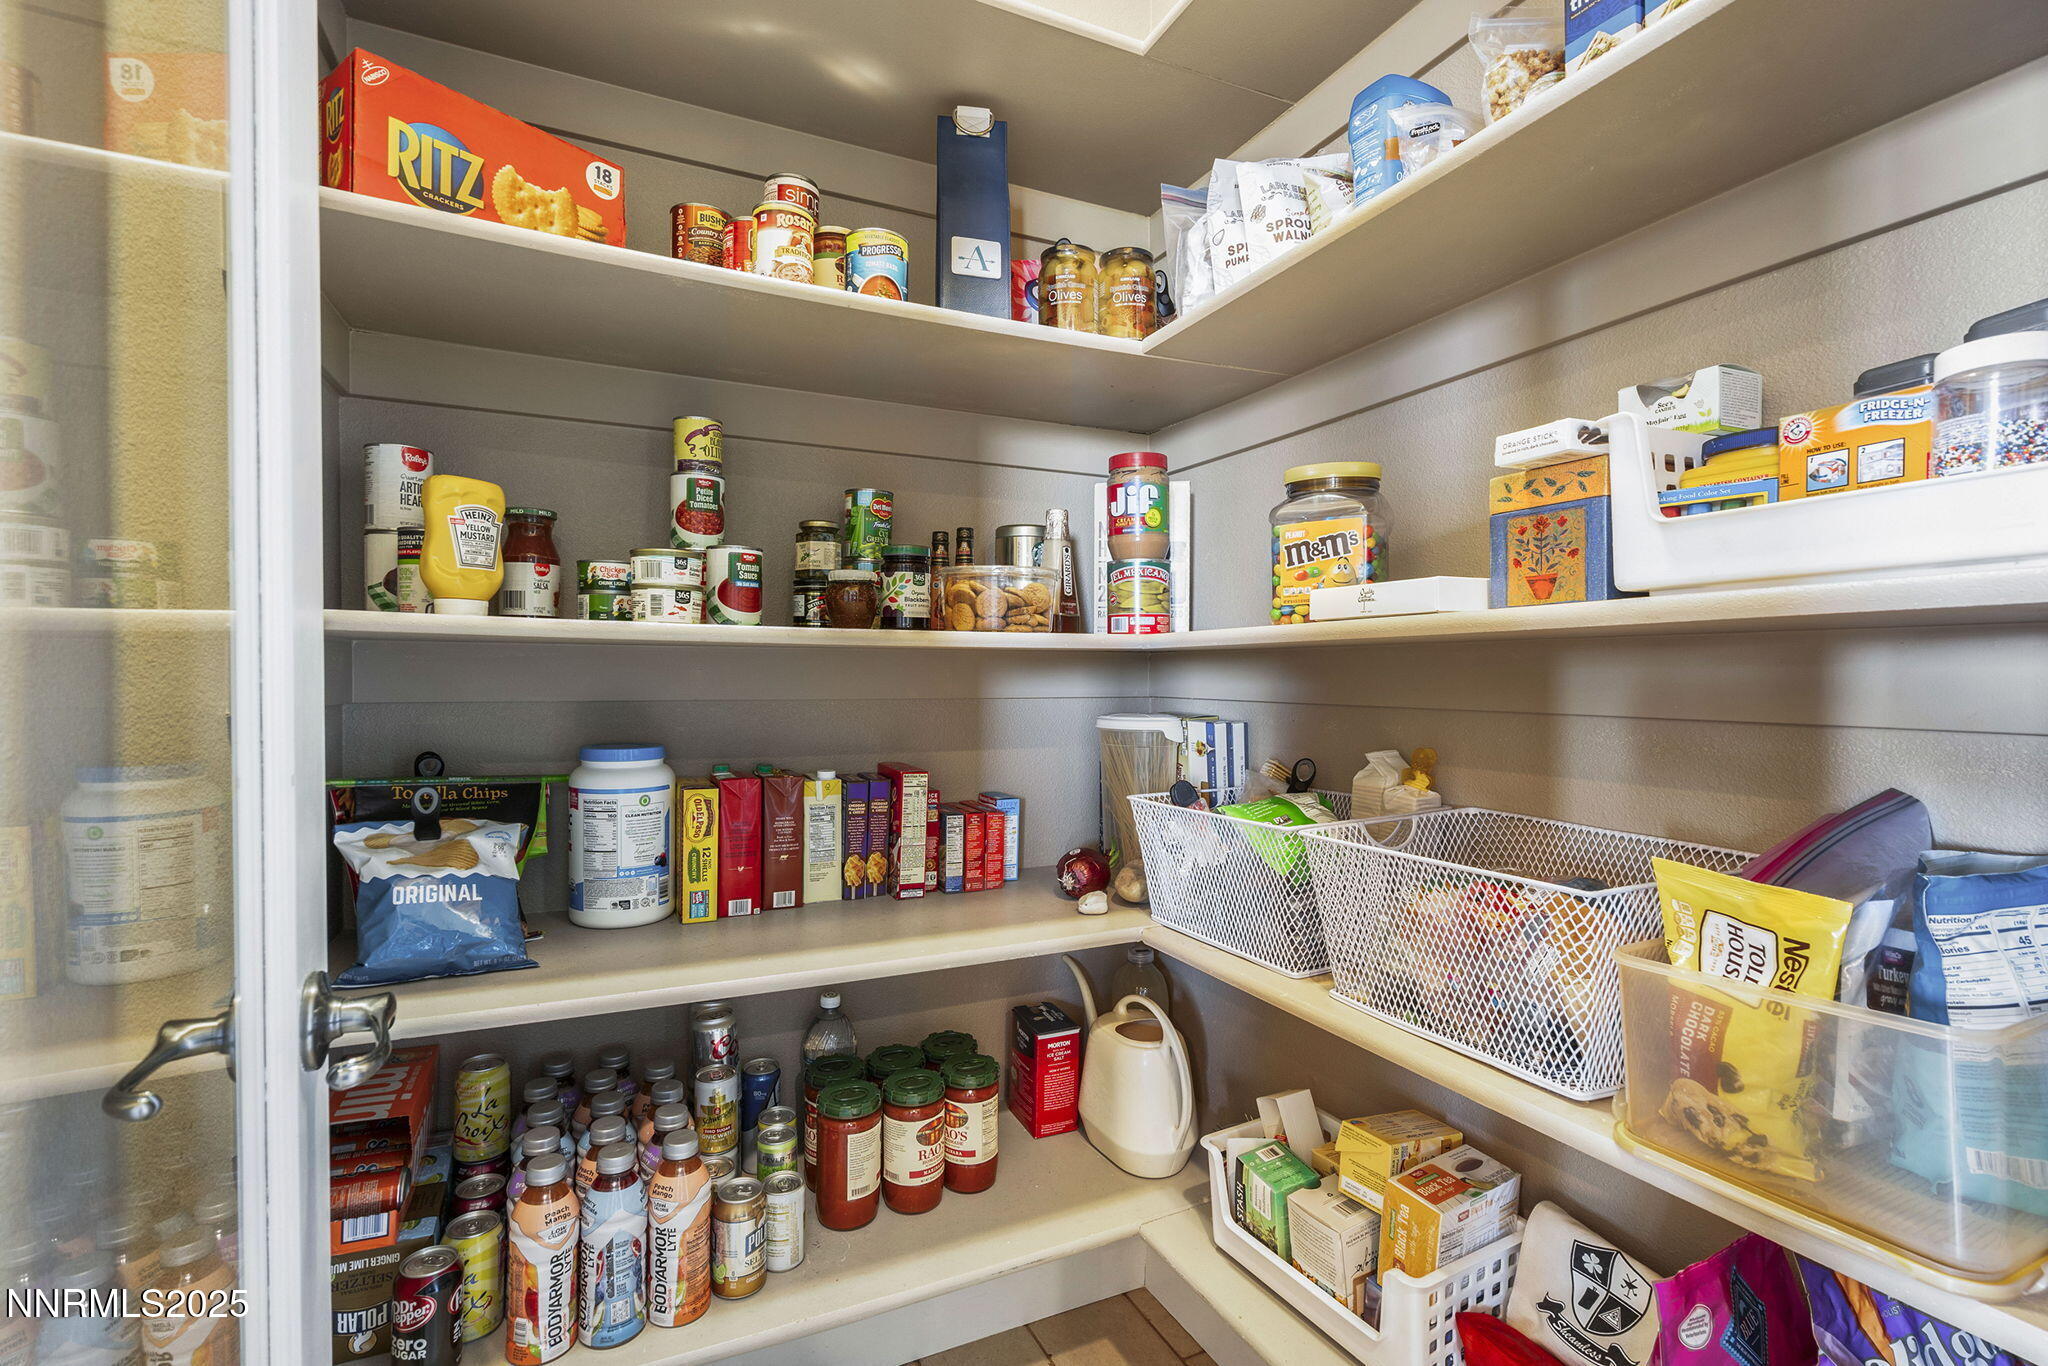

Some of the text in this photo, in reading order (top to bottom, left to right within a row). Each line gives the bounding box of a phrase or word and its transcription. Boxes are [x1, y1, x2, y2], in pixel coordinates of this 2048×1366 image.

[326, 87, 344, 138] RITZ
[387, 116, 486, 210] RITZ
[594, 165, 612, 184] 18
[1260, 182, 1290, 194] LARK
[422, 191, 464, 212] CRACKERS
[700, 213, 728, 228] BUSH'S
[1224, 210, 1244, 218] LAR
[776, 213, 814, 234] Rosar
[1266, 217, 1312, 232] SPROU
[691, 228, 718, 240] Country
[861, 246, 902, 256] PROGRESSO
[965, 245, 990, 272] A
[1048, 290, 1084, 302] Olives
[1112, 292, 1148, 304] Olives
[1657, 400, 1674, 408] See's
[1859, 397, 1932, 414] FRIDGE-N-
[1645, 416, 1670, 426] Mayfair
[1863, 408, 1924, 424] FREEZER
[1502, 437, 1532, 450] ORANGE
[1832, 442, 1846, 450] USE:
[404, 452, 428, 468] Raley's
[1733, 474, 1770, 484] CONTAINER
[696, 487, 714, 496] Petite
[696, 494, 714, 502] Diced
[1679, 488, 1732, 500] Food Color Set
[689, 501, 718, 512] Tomatoes
[1110, 484, 1158, 518] Jif
[464, 511, 492, 524] HEINZ
[465, 523, 492, 534] YELLOW
[459, 531, 496, 544] MUSTARD
[599, 565, 626, 574] Chicken
[736, 562, 760, 572] Tomato
[739, 571, 758, 580] Sauce
[914, 574, 926, 582] 365
[1113, 571, 1124, 582] EL
[533, 582, 550, 590] SALSA
[676, 591, 690, 600] 365
[467, 785, 508, 800] Chips
[702, 846, 712, 858] 12
[702, 858, 710, 882] SHELLS
[392, 883, 484, 906] ORIGINAL
[1928, 916, 1972, 924] Nutrition
[1723, 922, 1744, 978] HOUS
[1941, 935, 2034, 954] lories 45
[1696, 1006, 1716, 1042] DARK
[1048, 1040, 1072, 1050] MORTON
[1680, 1001, 1704, 1078] CHOCOLATE
[1709, 1024, 1720, 1054] CACAO
[1055, 1050, 1072, 1058] CREAM
[472, 1086, 498, 1118] La
[454, 1112, 506, 1142] Croix
[716, 1125, 732, 1134] SUGAR
[761, 1152, 794, 1164] FEVER-T
[918, 1142, 944, 1162] RAO
[578, 1166, 596, 1176] Peach
[654, 1183, 674, 1192] Peach
[1417, 1175, 1456, 1198] Black Tea
[652, 1189, 674, 1200] Mango
[1236, 1180, 1246, 1222] STASH
[544, 1205, 570, 1220] Peach
[545, 1212, 572, 1228] Mango
[548, 1229, 568, 1240] CALORIE
[550, 1224, 568, 1234] LOW
[1394, 1203, 1410, 1260] Black Tea
[667, 1227, 678, 1252] LYTE
[350, 1253, 400, 1270] GINGER LIME
[563, 1245, 574, 1274] LYTE
[587, 1243, 596, 1270] LYTE
[654, 1226, 668, 1314] BODYARMOR
[549, 1251, 564, 1348] BODYARMOR
[400, 1301, 418, 1314] Dr
[337, 1302, 388, 1334] POLAR
[1740, 1310, 1760, 1338] BLUE
[392, 1338, 428, 1350] zero
[1552, 1319, 1602, 1360] Sheamless
[392, 1349, 428, 1360] SUGAR
